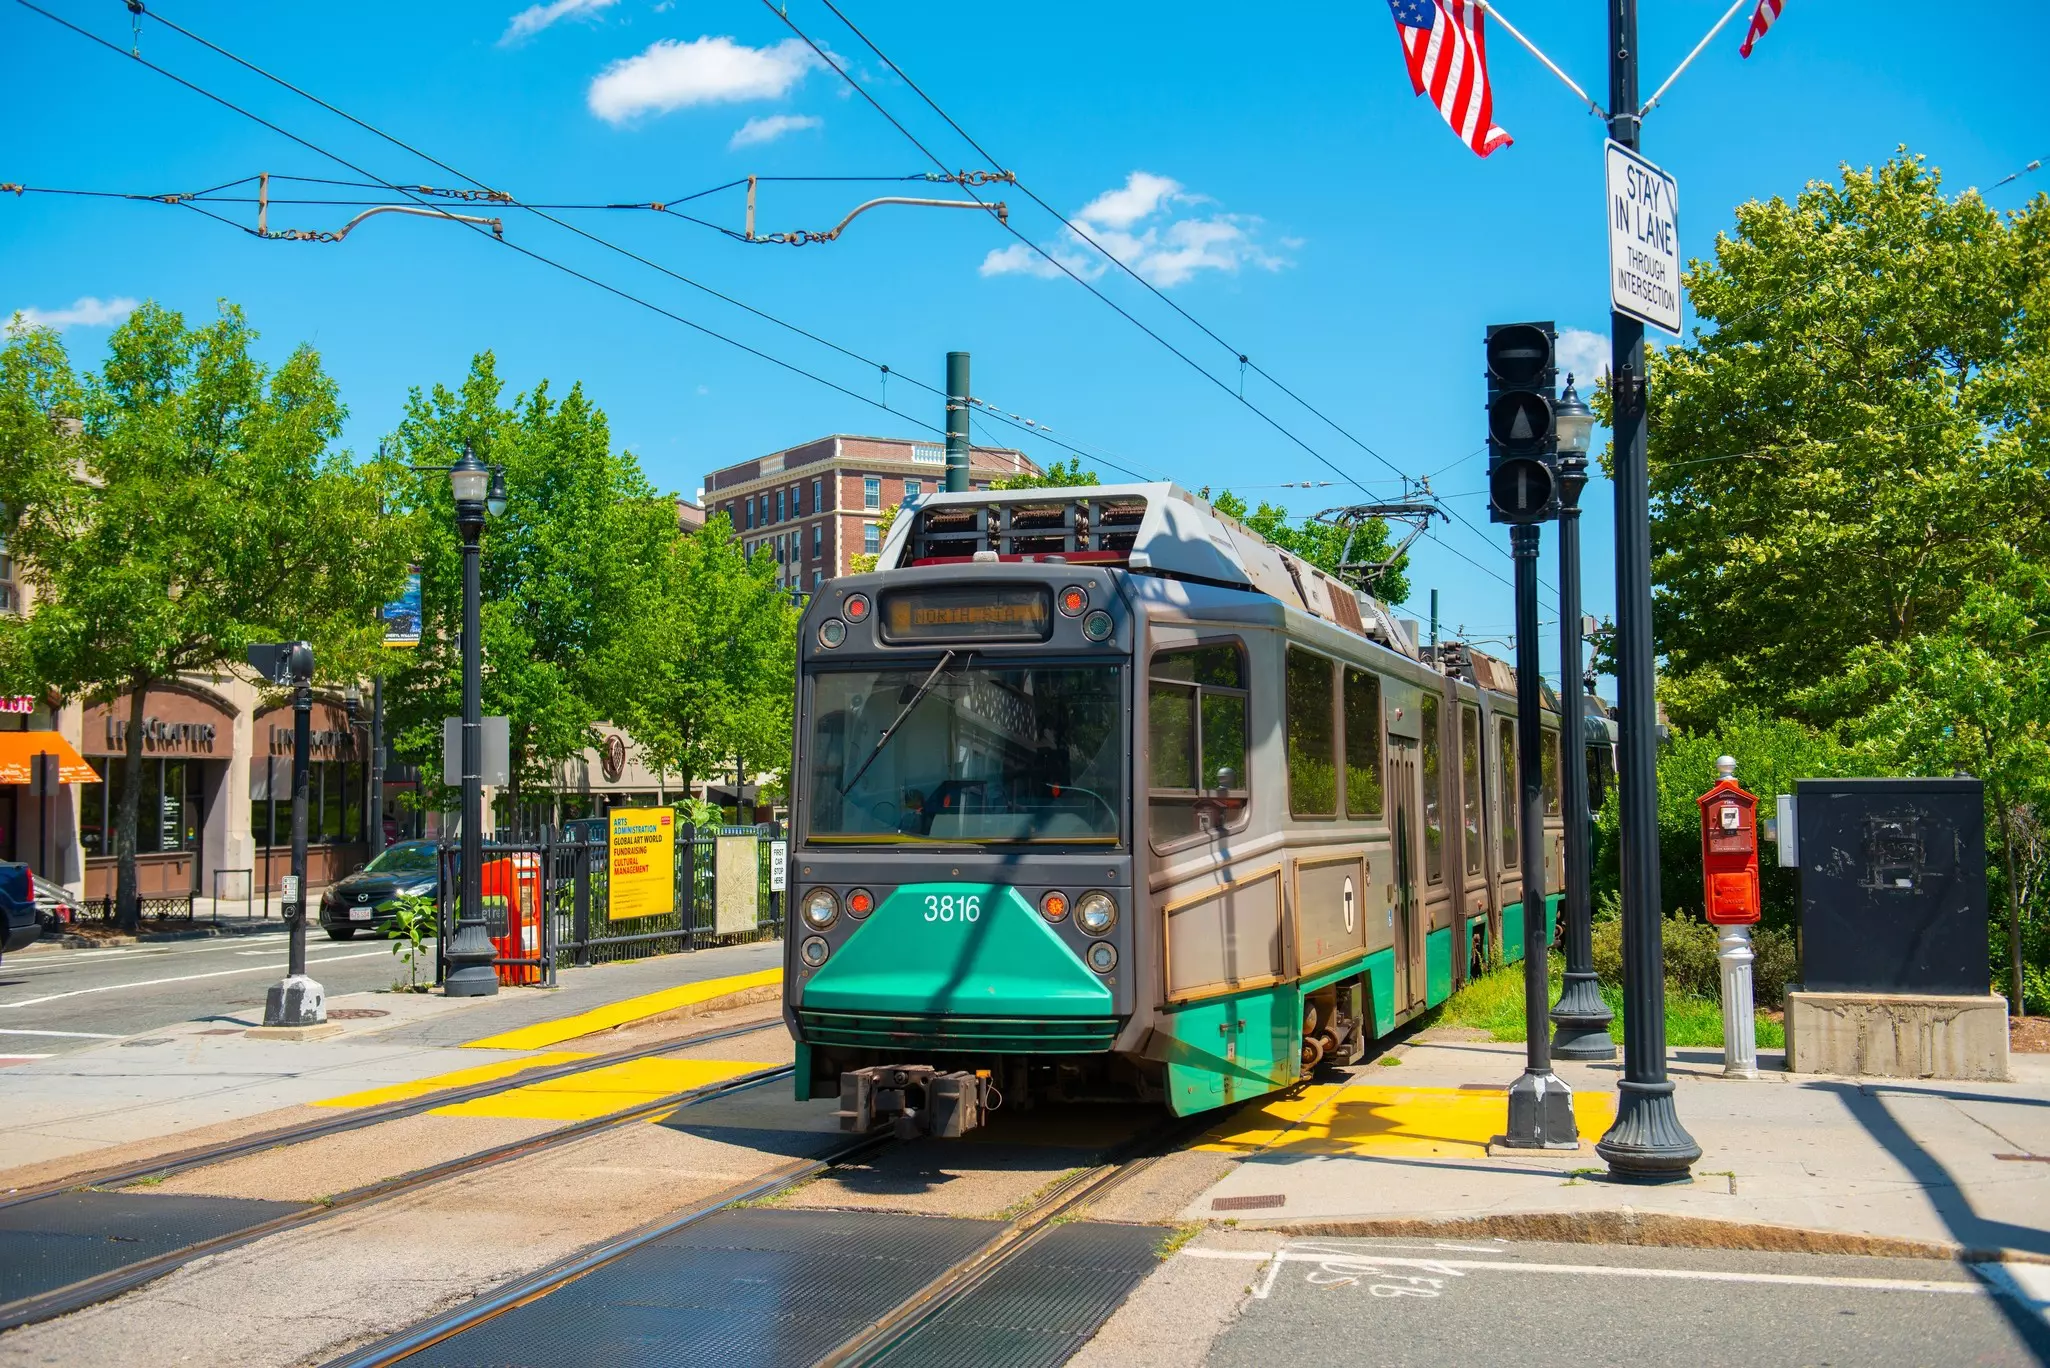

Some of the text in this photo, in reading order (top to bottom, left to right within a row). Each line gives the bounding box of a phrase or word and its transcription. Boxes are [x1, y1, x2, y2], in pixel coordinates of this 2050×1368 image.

[1627, 164, 1660, 212] STAY
[1615, 194, 1673, 257] IN LANE
[1627, 246, 1666, 283] THROUGH
[1618, 267, 1675, 312] INTERSECTION
[914, 608, 970, 624] NORTH
[613, 818, 628, 826] ARTS
[613, 824, 657, 835] ADMINISTRATION
[613, 834, 663, 846] GLOBAL ART WORLD
[613, 846, 648, 856] FUNDRAISING
[774, 848, 784, 856] FIRST
[613, 857, 639, 867] CULTURAL
[613, 864, 649, 876] MANAGEMENT
[774, 867, 784, 875] STOP
[924, 895, 980, 922] 3816
